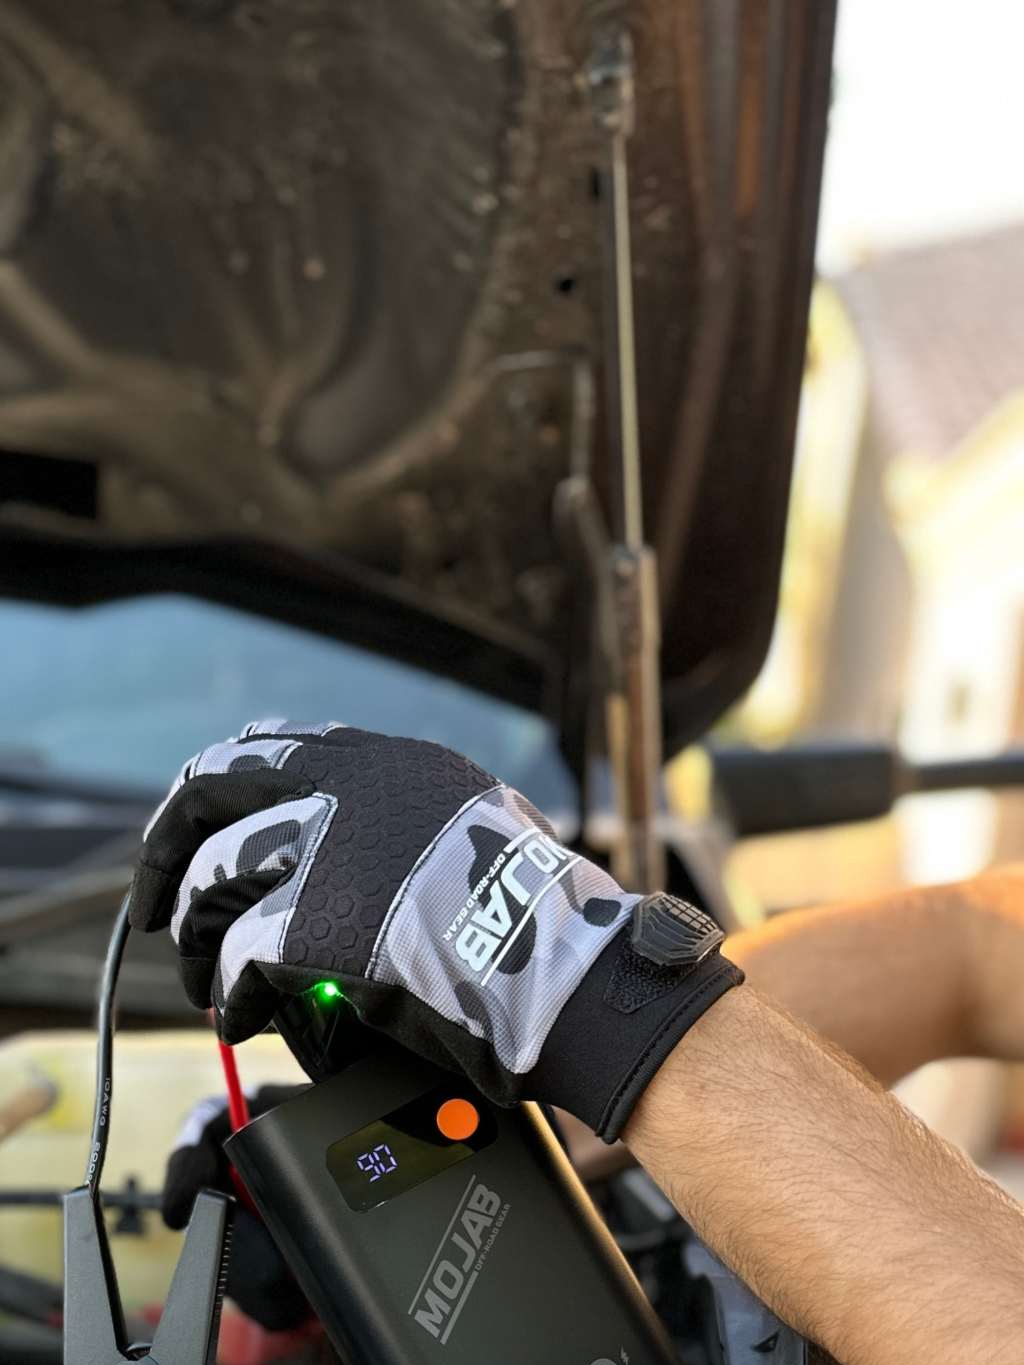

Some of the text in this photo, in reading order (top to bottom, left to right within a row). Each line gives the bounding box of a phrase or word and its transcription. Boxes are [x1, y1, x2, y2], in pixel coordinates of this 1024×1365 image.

[443, 853, 506, 940] OFF-ROAD GEAR
[357, 1144, 398, 1182] 90
[414, 1183, 502, 1338] MOJAB
